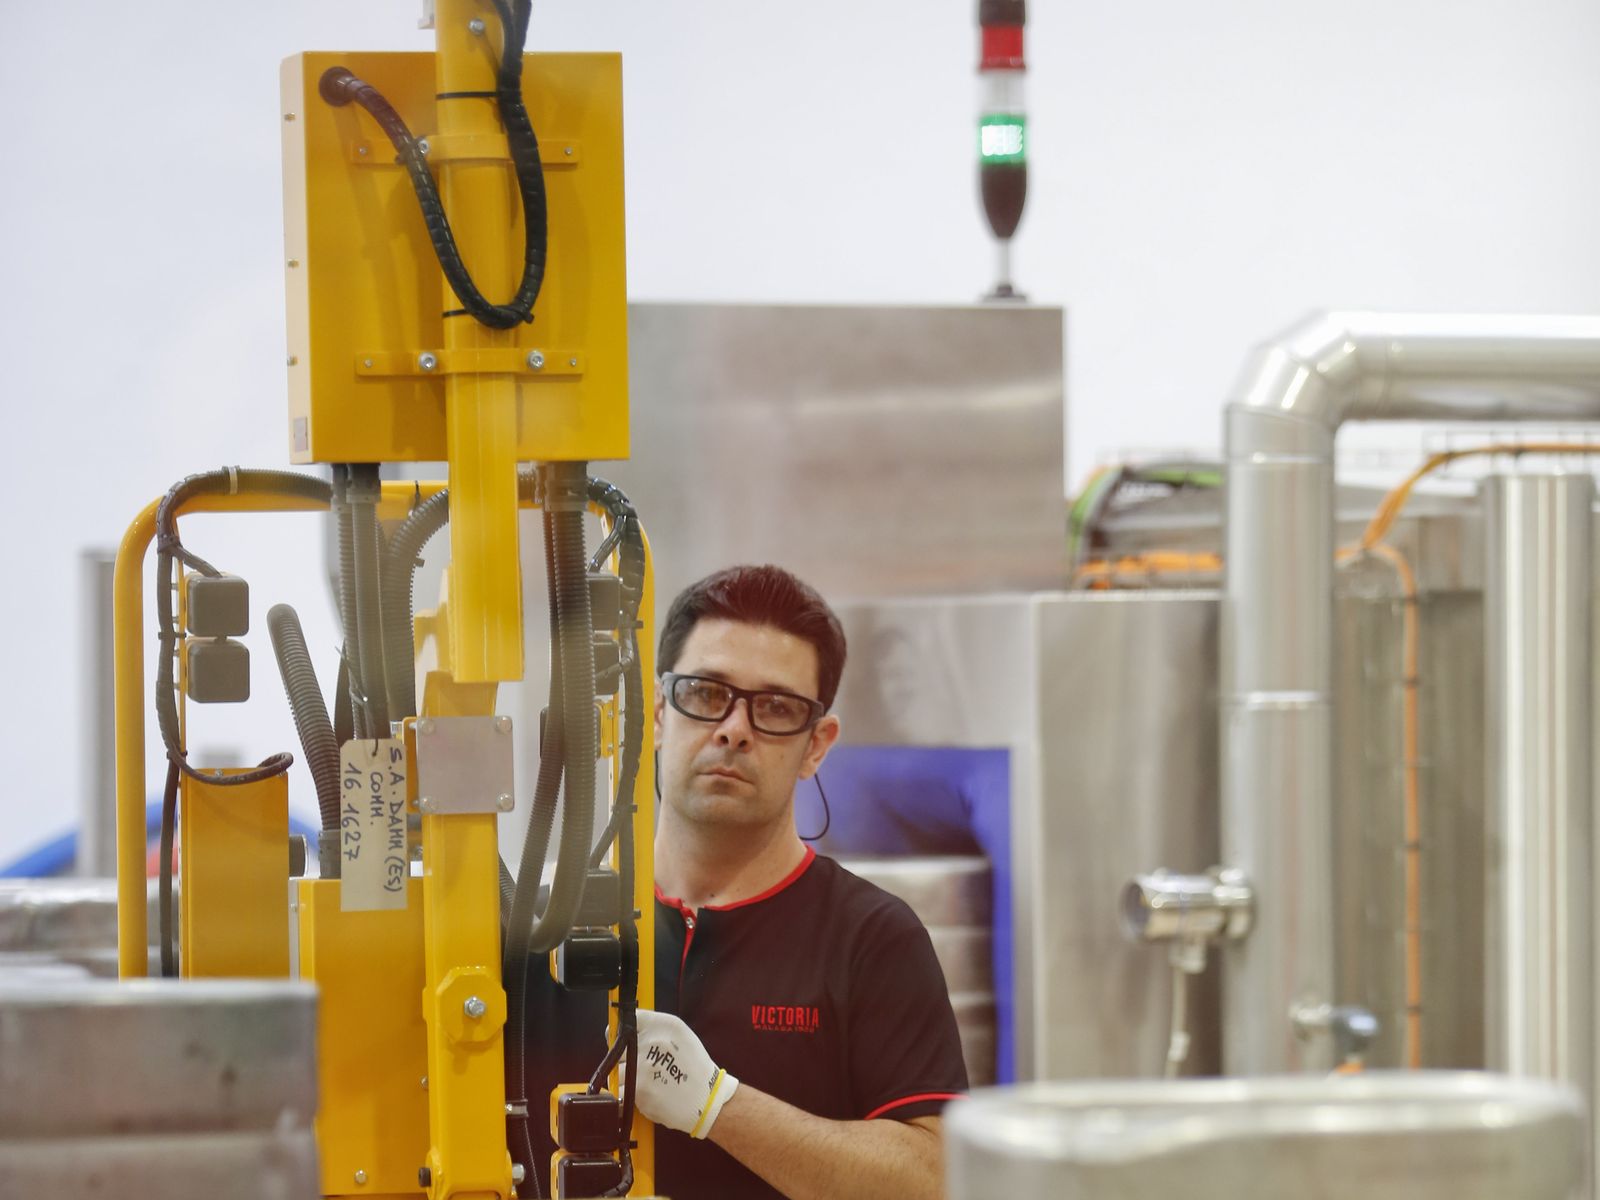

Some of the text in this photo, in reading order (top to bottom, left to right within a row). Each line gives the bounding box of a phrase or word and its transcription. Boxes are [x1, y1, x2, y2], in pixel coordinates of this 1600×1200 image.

[341, 762, 363, 862] 16.1627
[369, 771, 385, 826] COMM.
[383, 746, 406, 892] S.A. DAMM (ES)
[751, 1005, 819, 1026] VICTORIA
